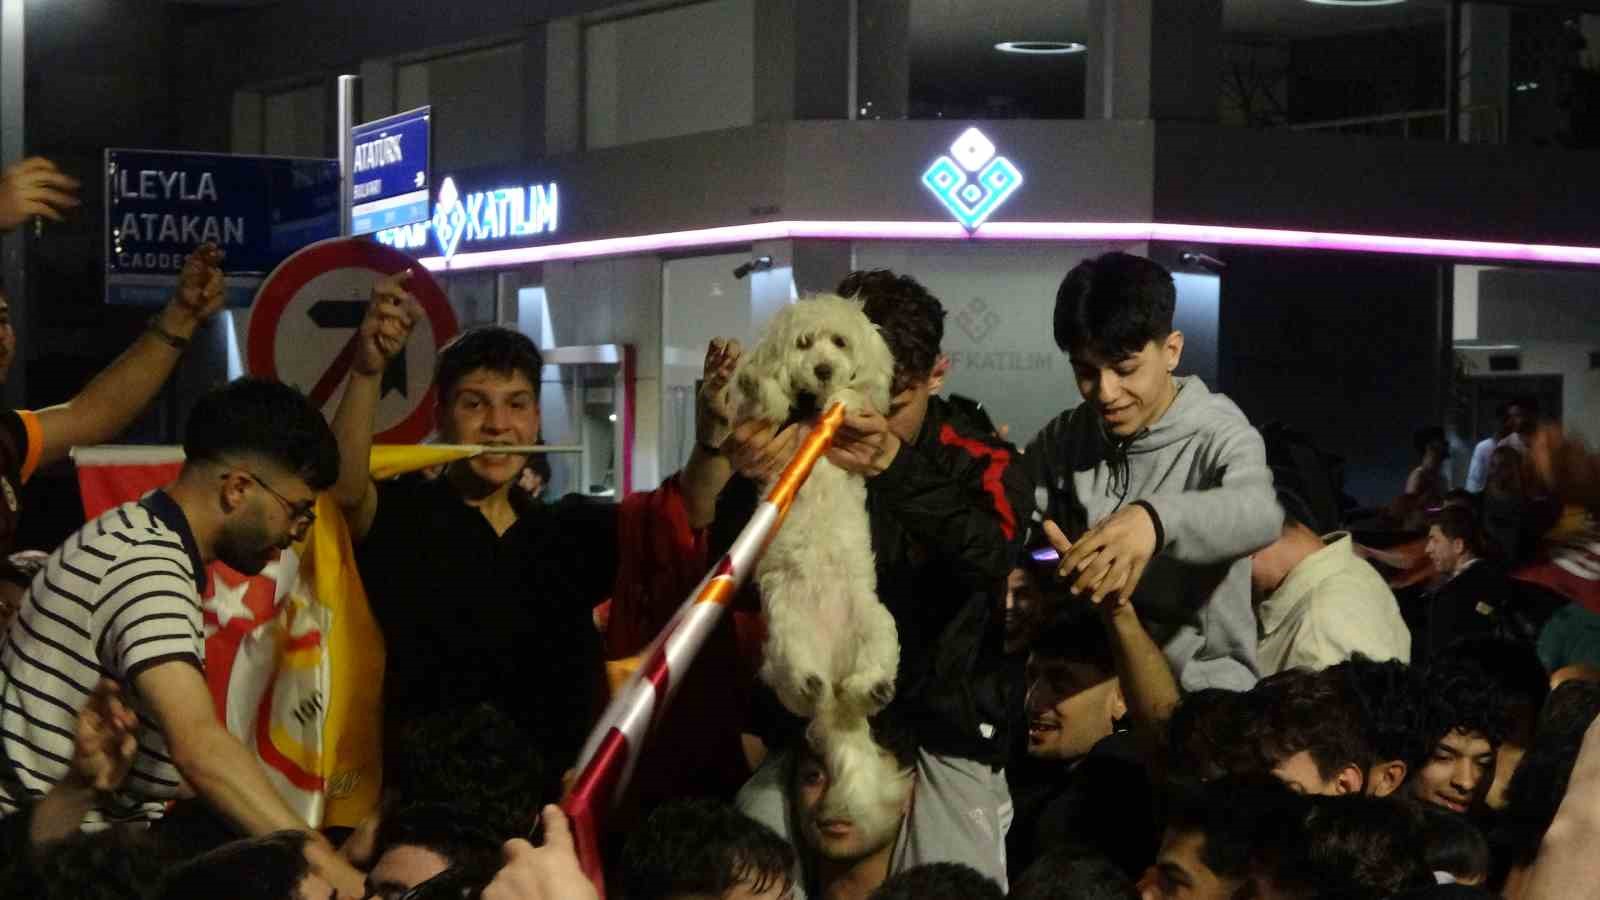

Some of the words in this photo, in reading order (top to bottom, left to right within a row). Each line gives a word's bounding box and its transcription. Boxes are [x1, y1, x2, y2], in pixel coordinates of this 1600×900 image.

[120, 169, 217, 200] LEYLA
[466, 182, 558, 241] KATILIM
[121, 213, 245, 244] ATAKAN
[120, 253, 188, 268] CADDE
[966, 351, 1052, 369] KATILIM
